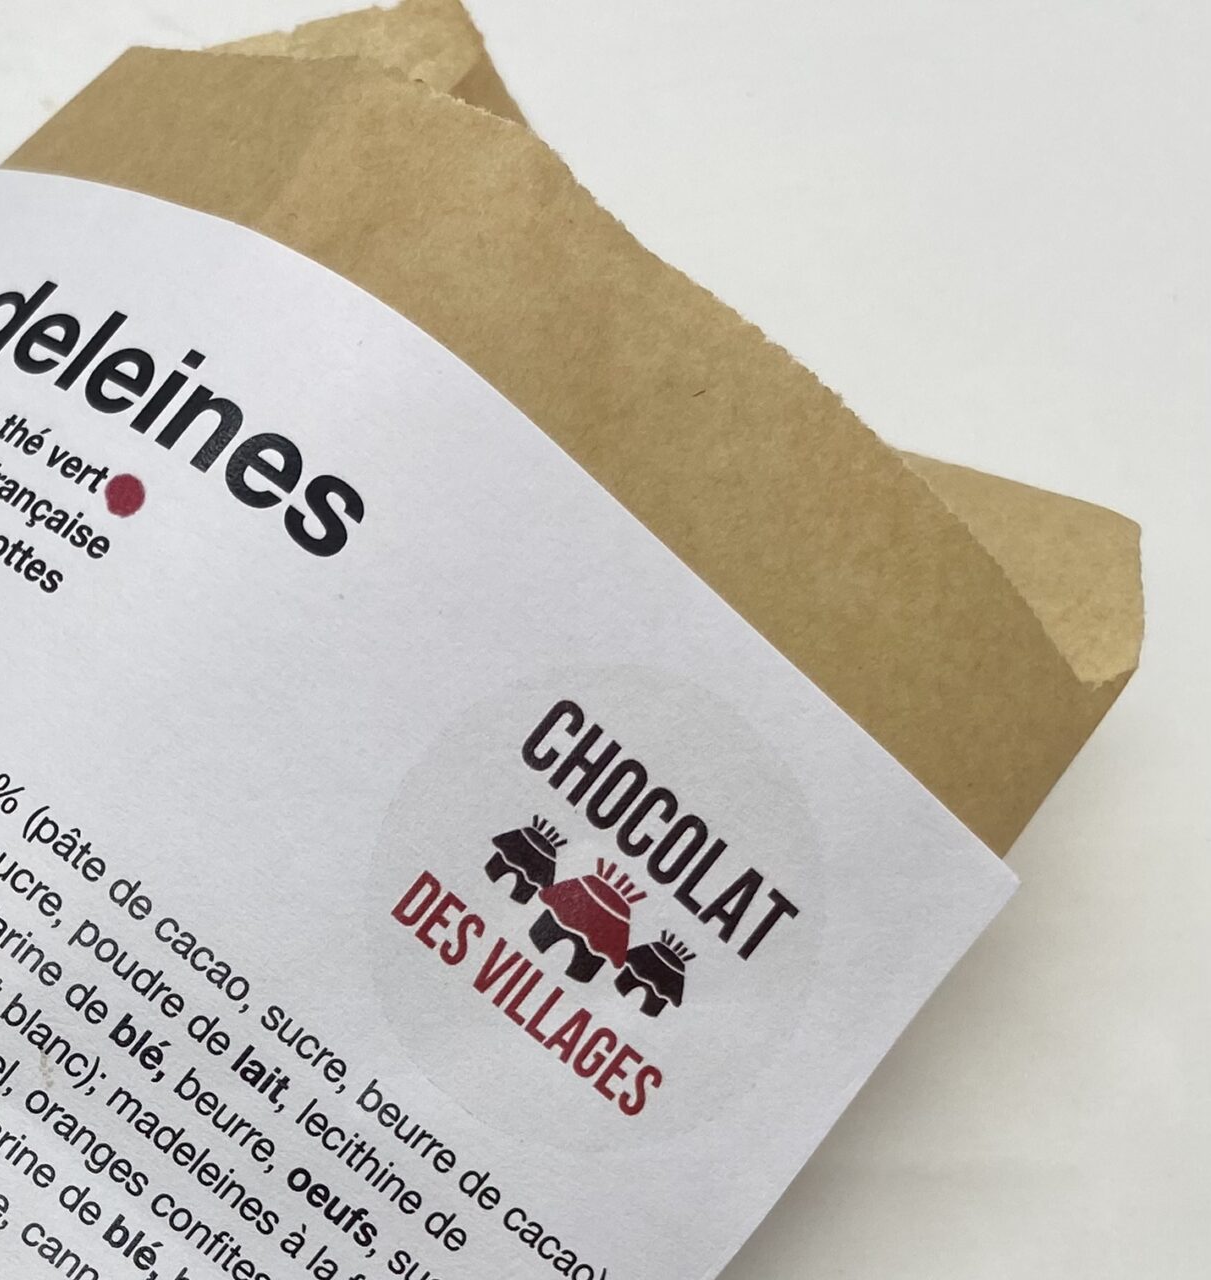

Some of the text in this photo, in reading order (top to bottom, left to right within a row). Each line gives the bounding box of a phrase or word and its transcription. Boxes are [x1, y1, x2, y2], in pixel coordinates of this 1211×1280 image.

[46, 445, 109, 494] vert
[522, 700, 800, 961] CHOCOLAT
[23, 806, 106, 882] (pâte
[109, 879, 152, 920] de
[155, 918, 249, 1013] cacao,
[261, 1006, 346, 1094] sucre,
[356, 1079, 456, 1173] beurre
[459, 1170, 500, 1210] de
[65, 984, 108, 1024] de
[109, 1013, 171, 1082] blé,
[173, 1067, 275, 1173] beurre,
[287, 1167, 377, 1258] oeufs,
[68, 919, 184, 1018] poudre
[187, 1015, 230, 1055] de
[231, 1045, 290, 1113] lait,
[295, 1098, 422, 1214] lecithine
[425, 1212, 466, 1251] de
[391, 870, 662, 1116] DES VILLAGES
[0, 993, 106, 1096] blanc);
[106, 1087, 279, 1235] madeleines
[280, 1224, 306, 1259] à
[25, 1090, 149, 1196] oranges
[59, 1186, 101, 1225] de
